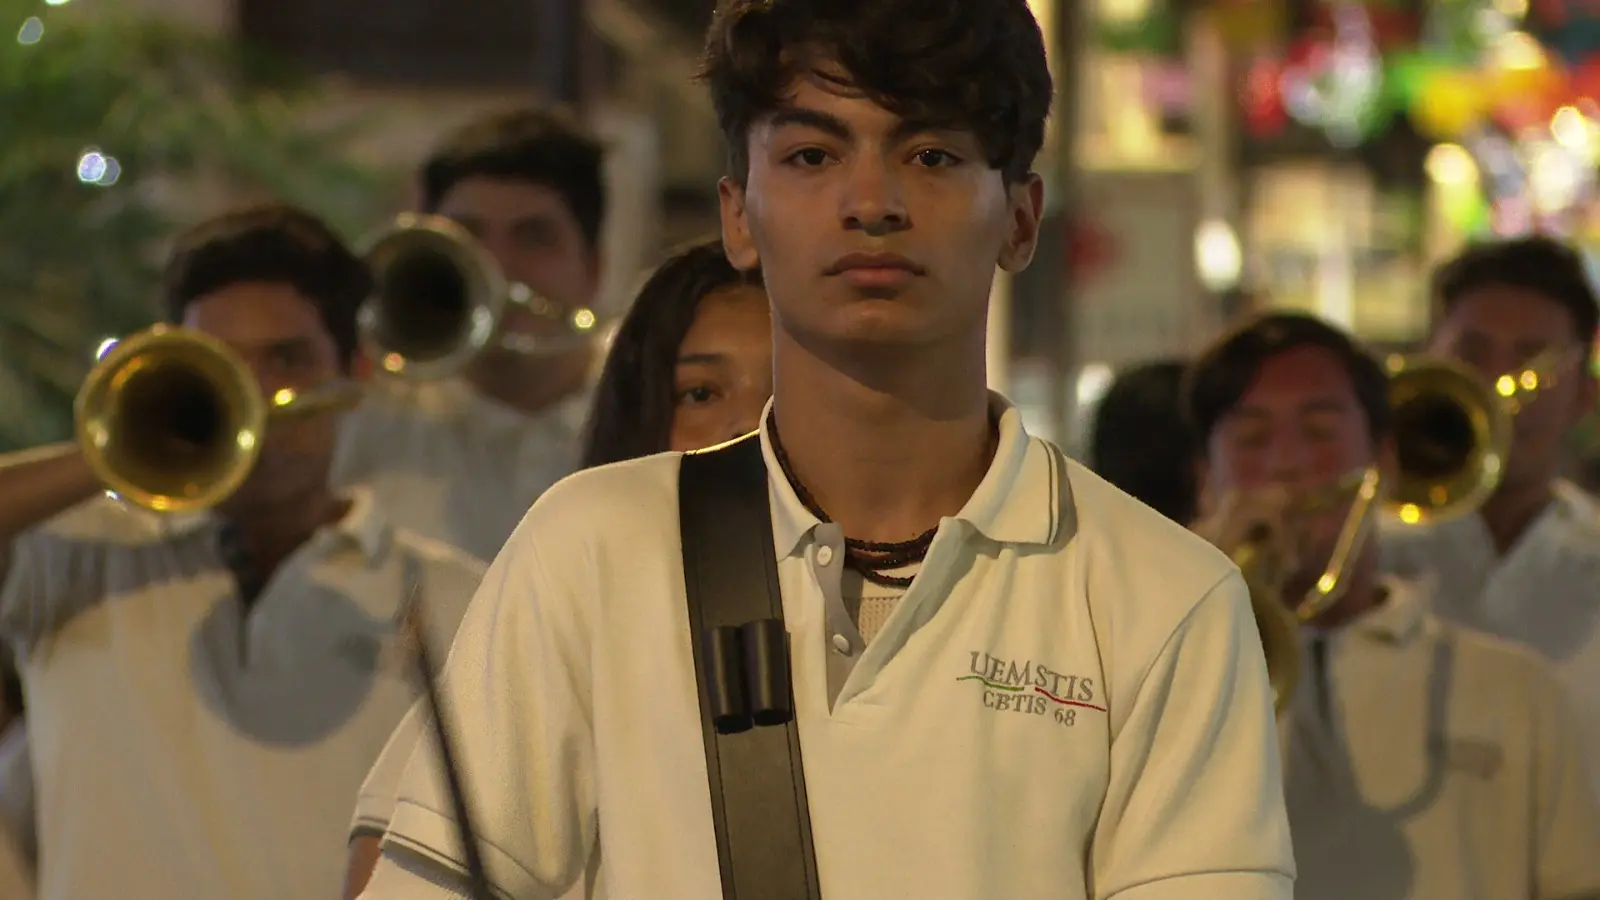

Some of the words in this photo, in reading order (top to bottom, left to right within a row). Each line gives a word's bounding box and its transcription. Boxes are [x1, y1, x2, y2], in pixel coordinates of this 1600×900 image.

[970, 651, 1094, 702] UEMSTIS
[983, 690, 1047, 715] CBTIS
[1054, 708, 1076, 727] 68
